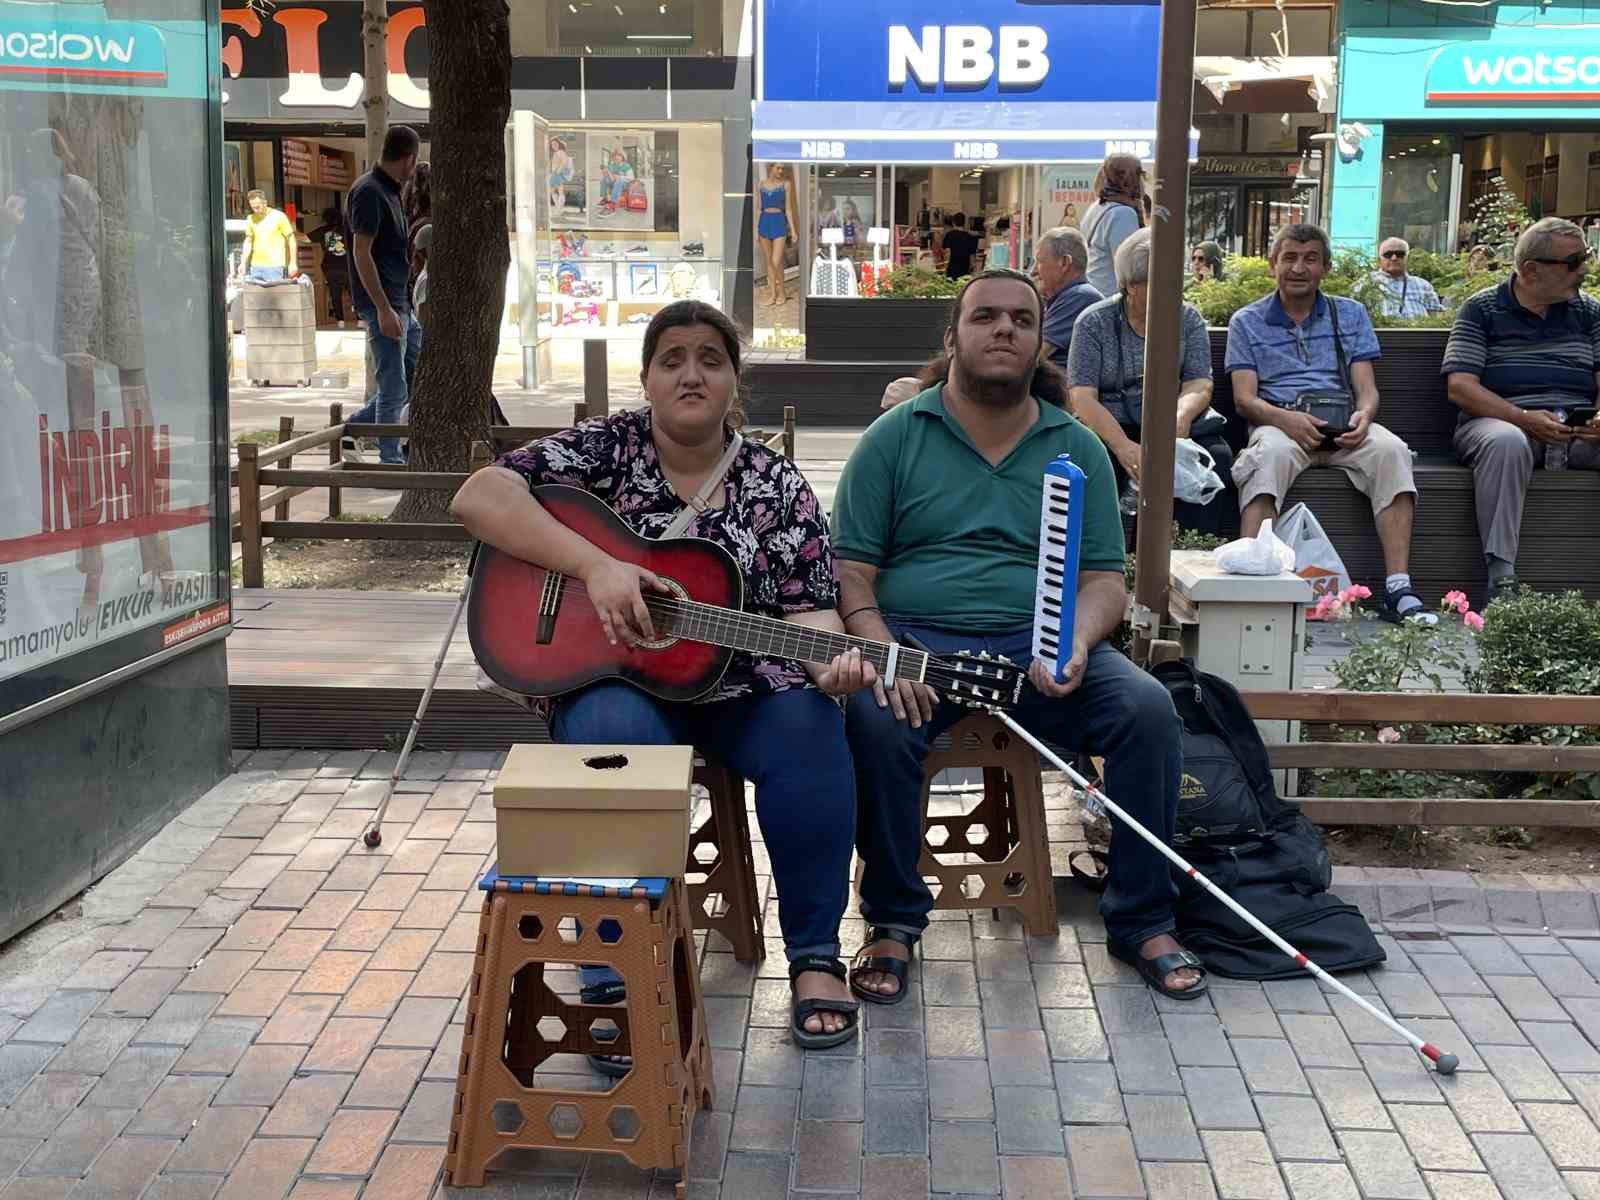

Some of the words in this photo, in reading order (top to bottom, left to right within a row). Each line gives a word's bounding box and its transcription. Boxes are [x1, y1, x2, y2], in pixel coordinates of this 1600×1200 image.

[887, 25, 1050, 92] NBB
[801, 141, 846, 158] NBB
[954, 142, 999, 159] NBB
[39, 409, 171, 533] İNDİRİM
